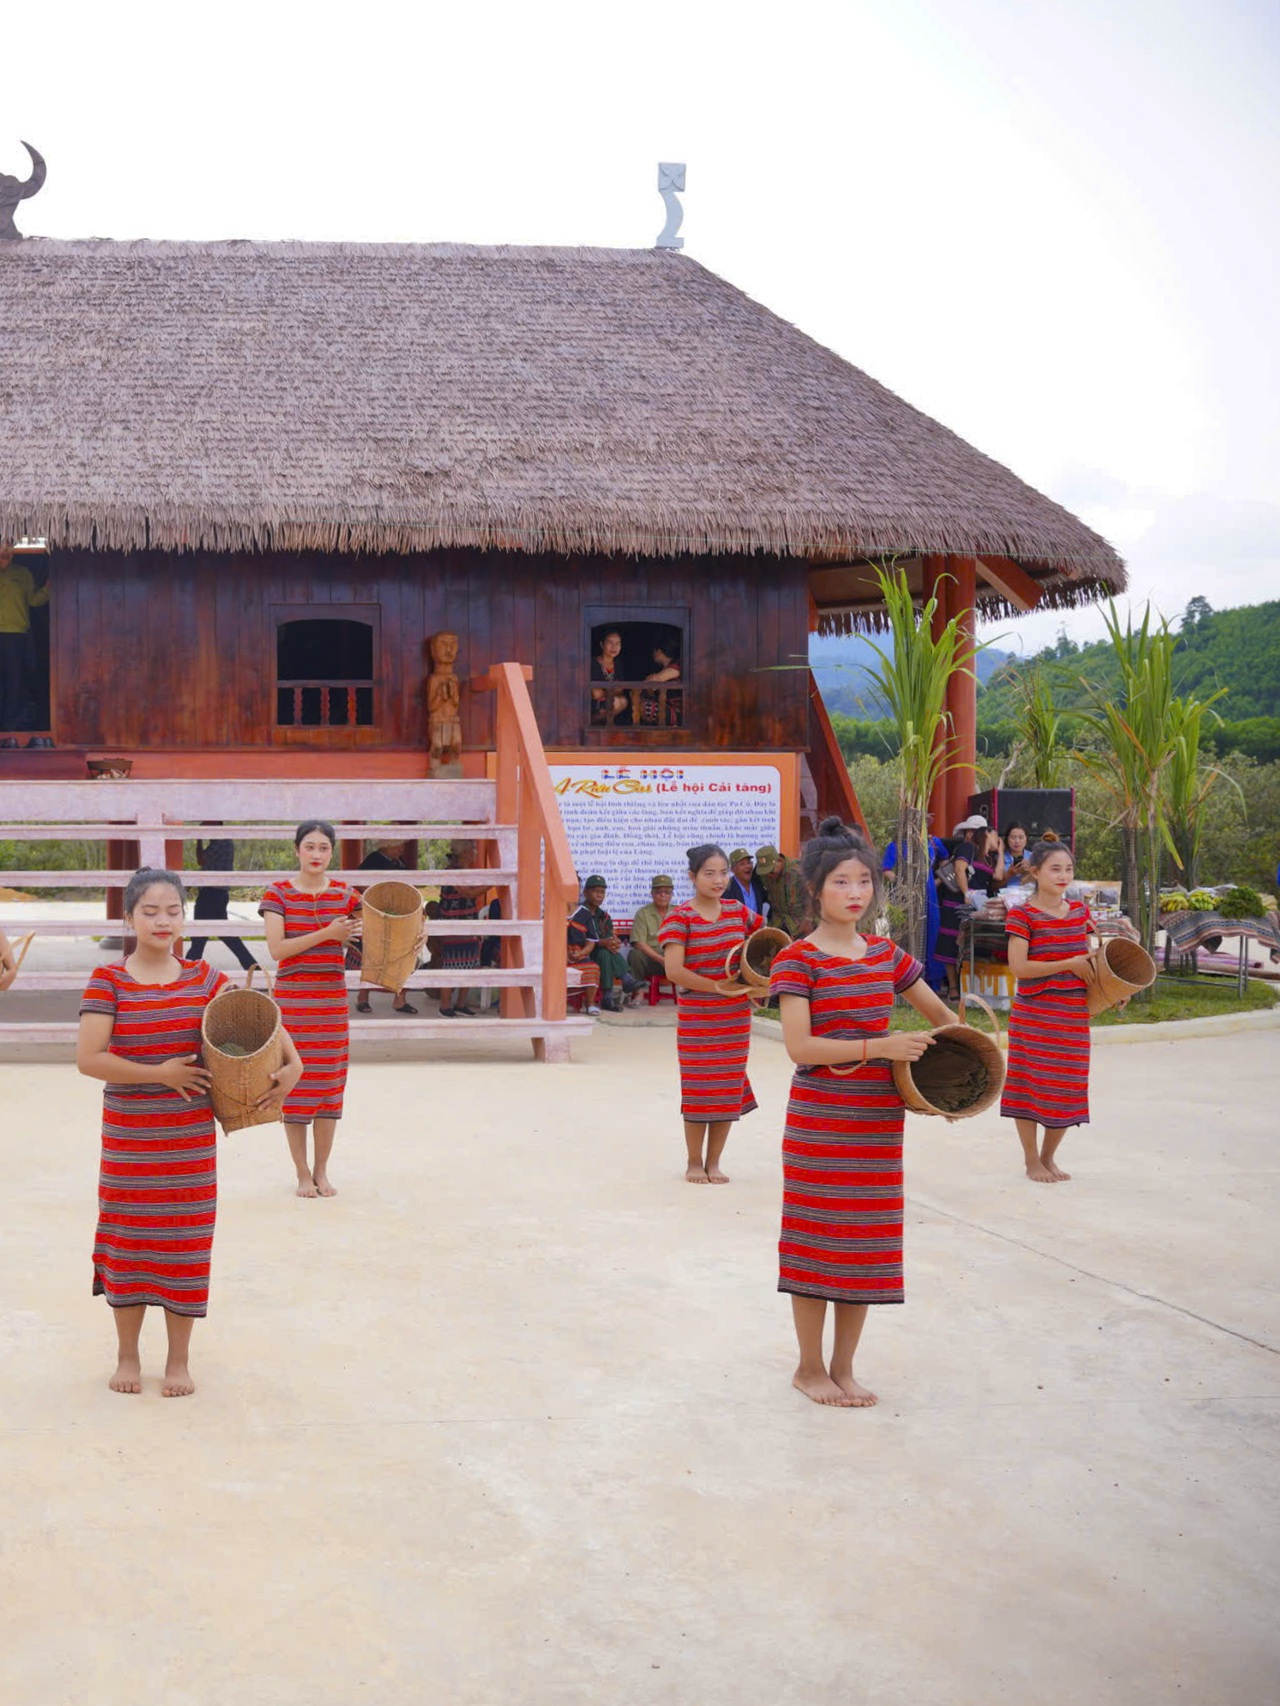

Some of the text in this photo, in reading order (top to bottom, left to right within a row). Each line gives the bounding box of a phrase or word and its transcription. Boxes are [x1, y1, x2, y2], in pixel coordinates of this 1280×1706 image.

[601, 766, 684, 781] LỄ HỘI
[656, 781, 678, 794] (Lễ
[683, 782, 704, 795] hội
[709, 782, 731, 792] Cải
